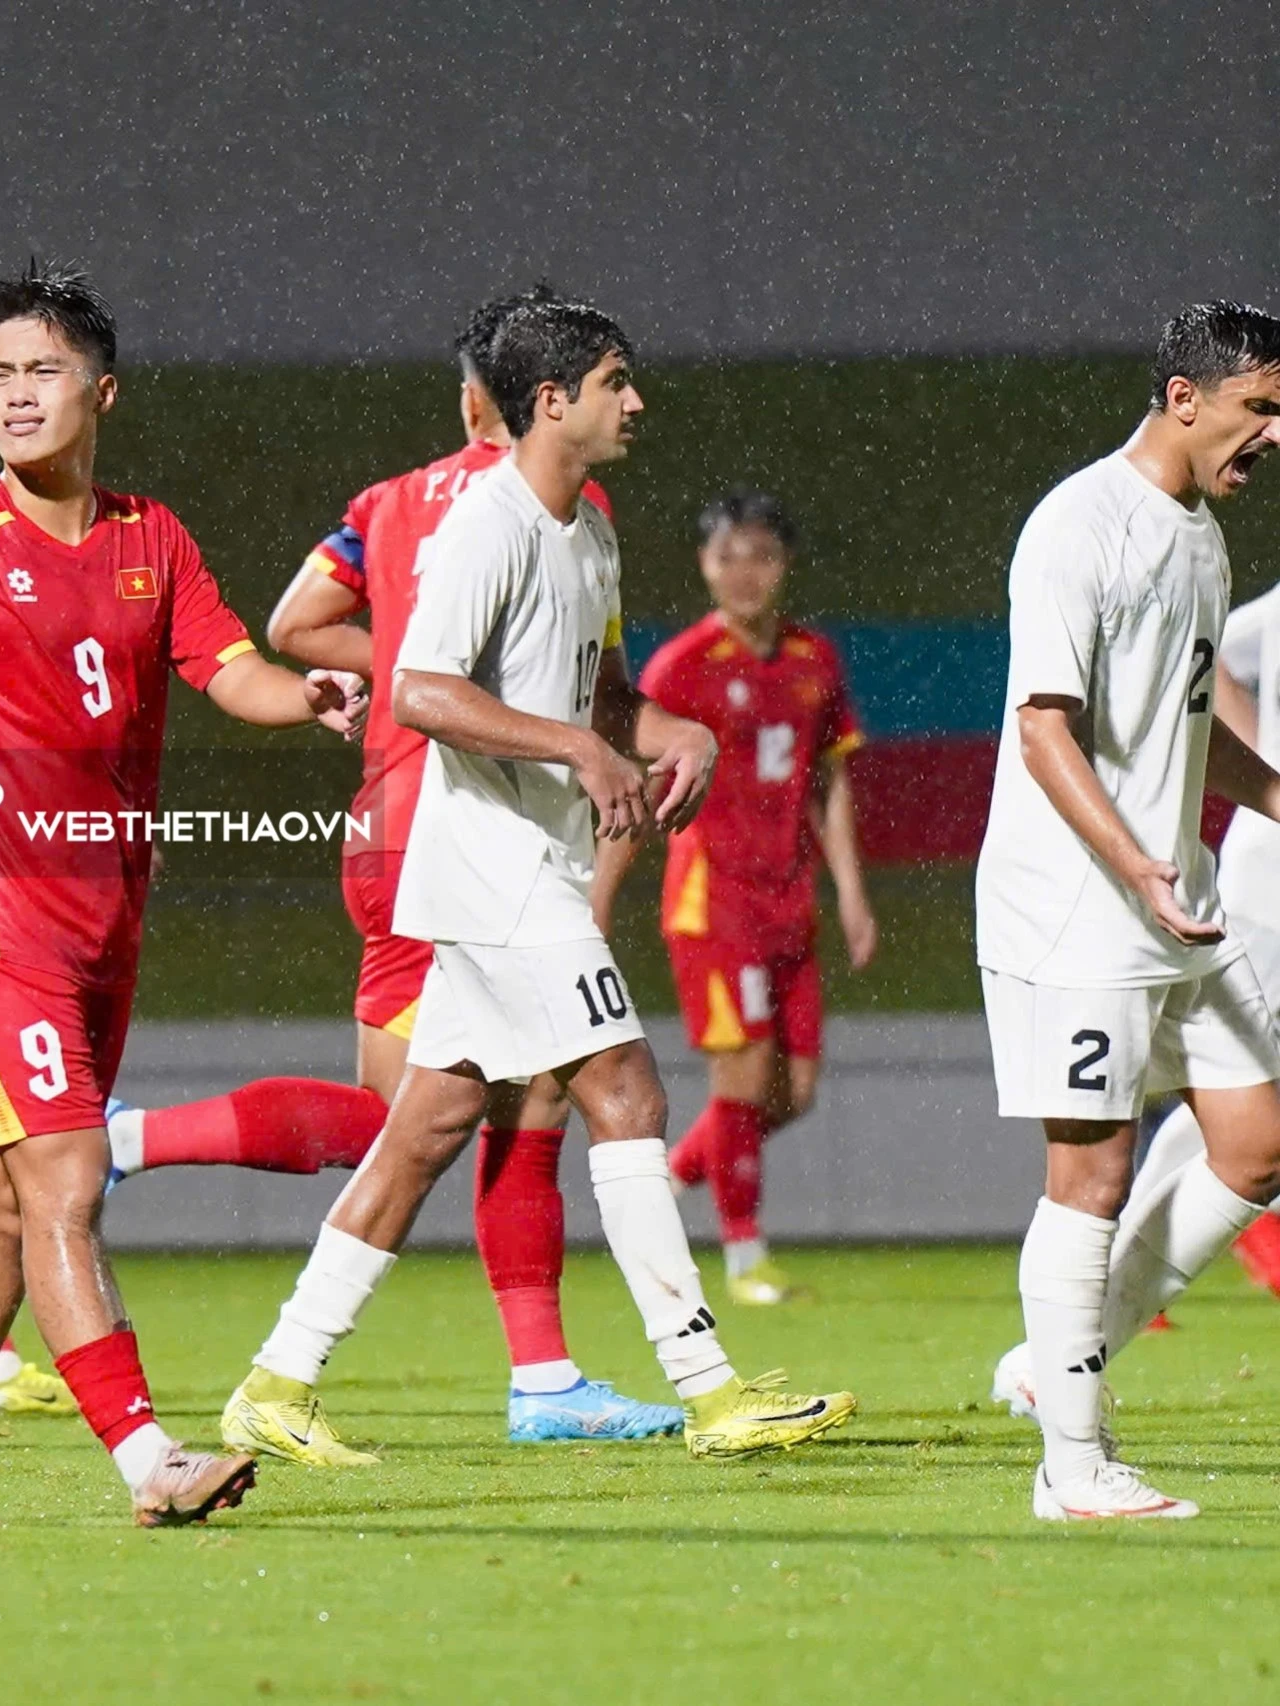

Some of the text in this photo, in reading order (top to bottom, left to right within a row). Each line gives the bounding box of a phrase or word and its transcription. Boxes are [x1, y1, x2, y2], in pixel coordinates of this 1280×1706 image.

[423, 468, 485, 502] P.L
[73, 636, 112, 719] 9
[576, 639, 598, 713] 10
[1187, 637, 1214, 715] 2
[576, 966, 627, 1027] 10
[19, 1019, 69, 1102] 9
[1067, 1029, 1110, 1091] 2
